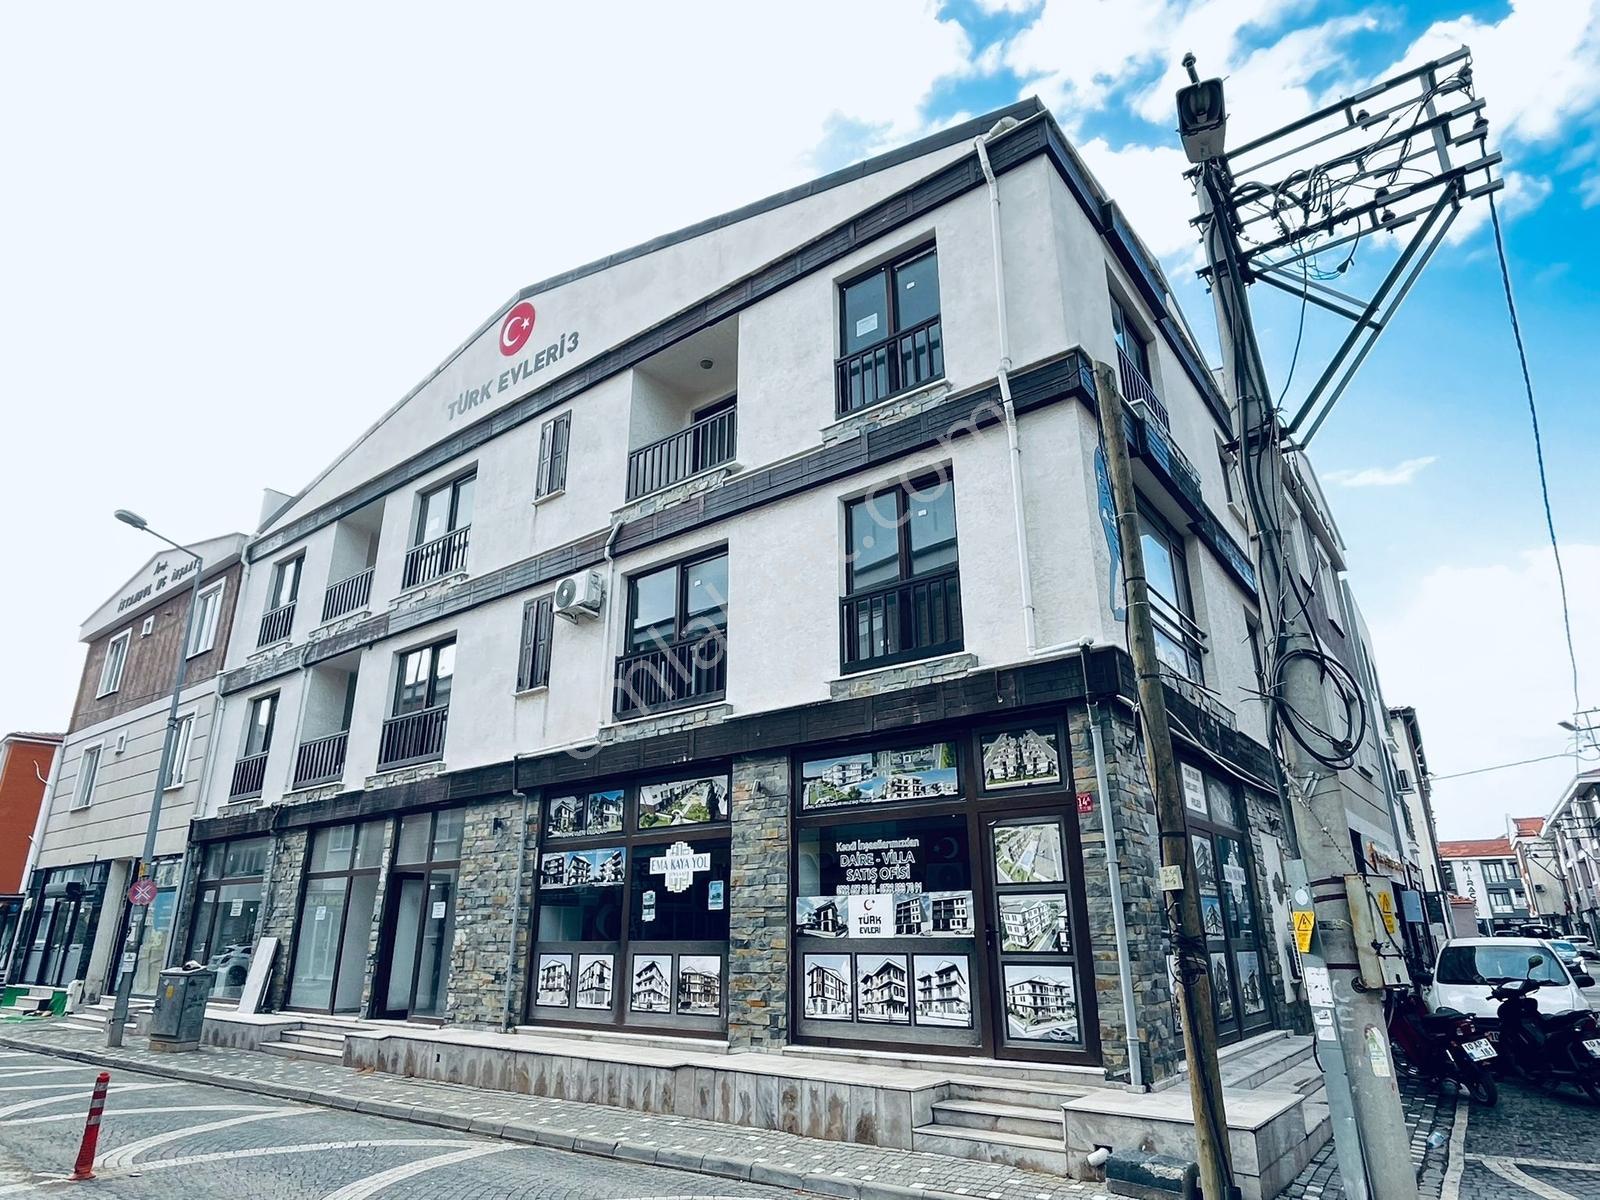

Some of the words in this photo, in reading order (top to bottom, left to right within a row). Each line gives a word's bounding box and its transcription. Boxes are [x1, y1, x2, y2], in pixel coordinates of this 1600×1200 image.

[671, 857, 690, 870] KAYA
[692, 856, 709, 869] YOL
[840, 851, 875, 867] DAİRE
[881, 849, 916, 865] VİLLA
[846, 866, 878, 883] SATIŞ
[879, 863, 911, 881] OFİSİ
[858, 913, 882, 925] TÜRK
